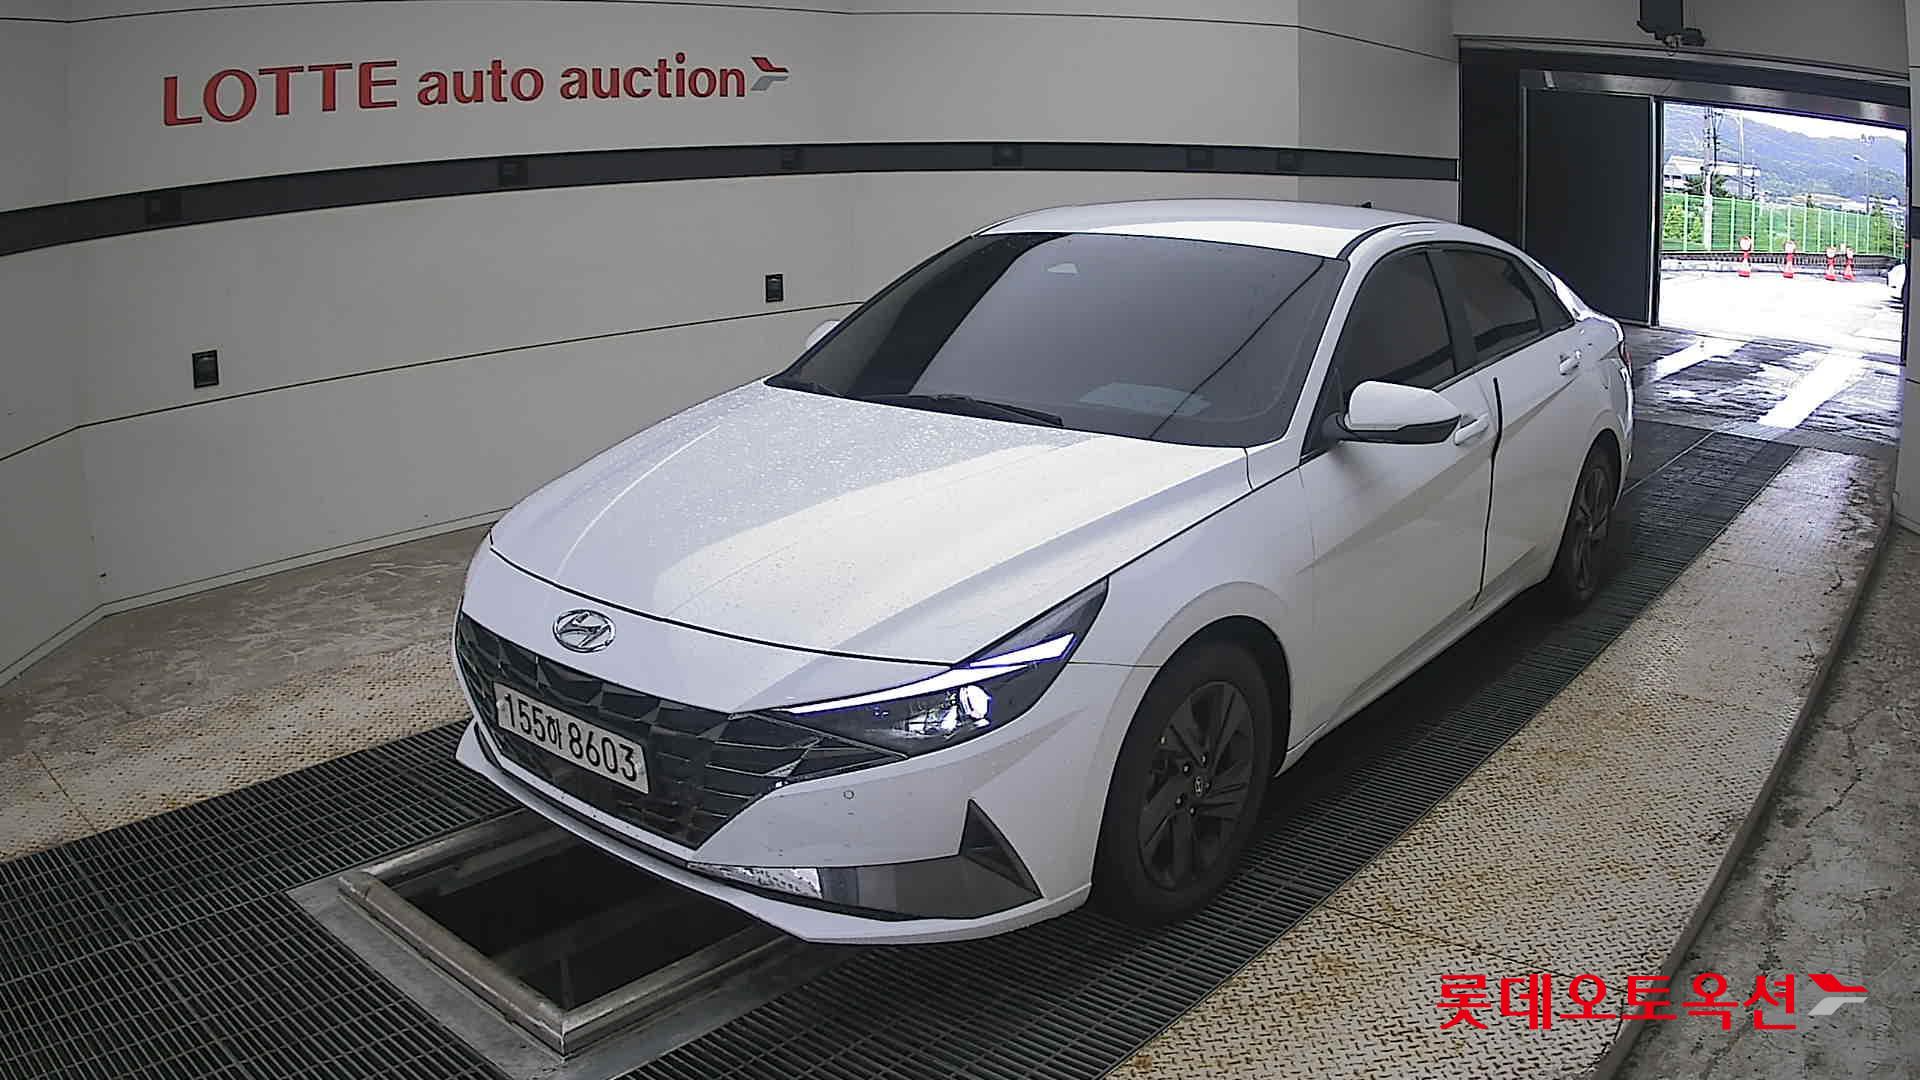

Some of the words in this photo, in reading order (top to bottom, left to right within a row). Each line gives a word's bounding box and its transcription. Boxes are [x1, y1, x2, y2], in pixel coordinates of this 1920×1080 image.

[163, 61, 398, 126] LOTTE
[416, 59, 544, 106] auto
[559, 52, 746, 100] auction
[504, 692, 563, 750] 155하
[567, 721, 638, 782] 8603
